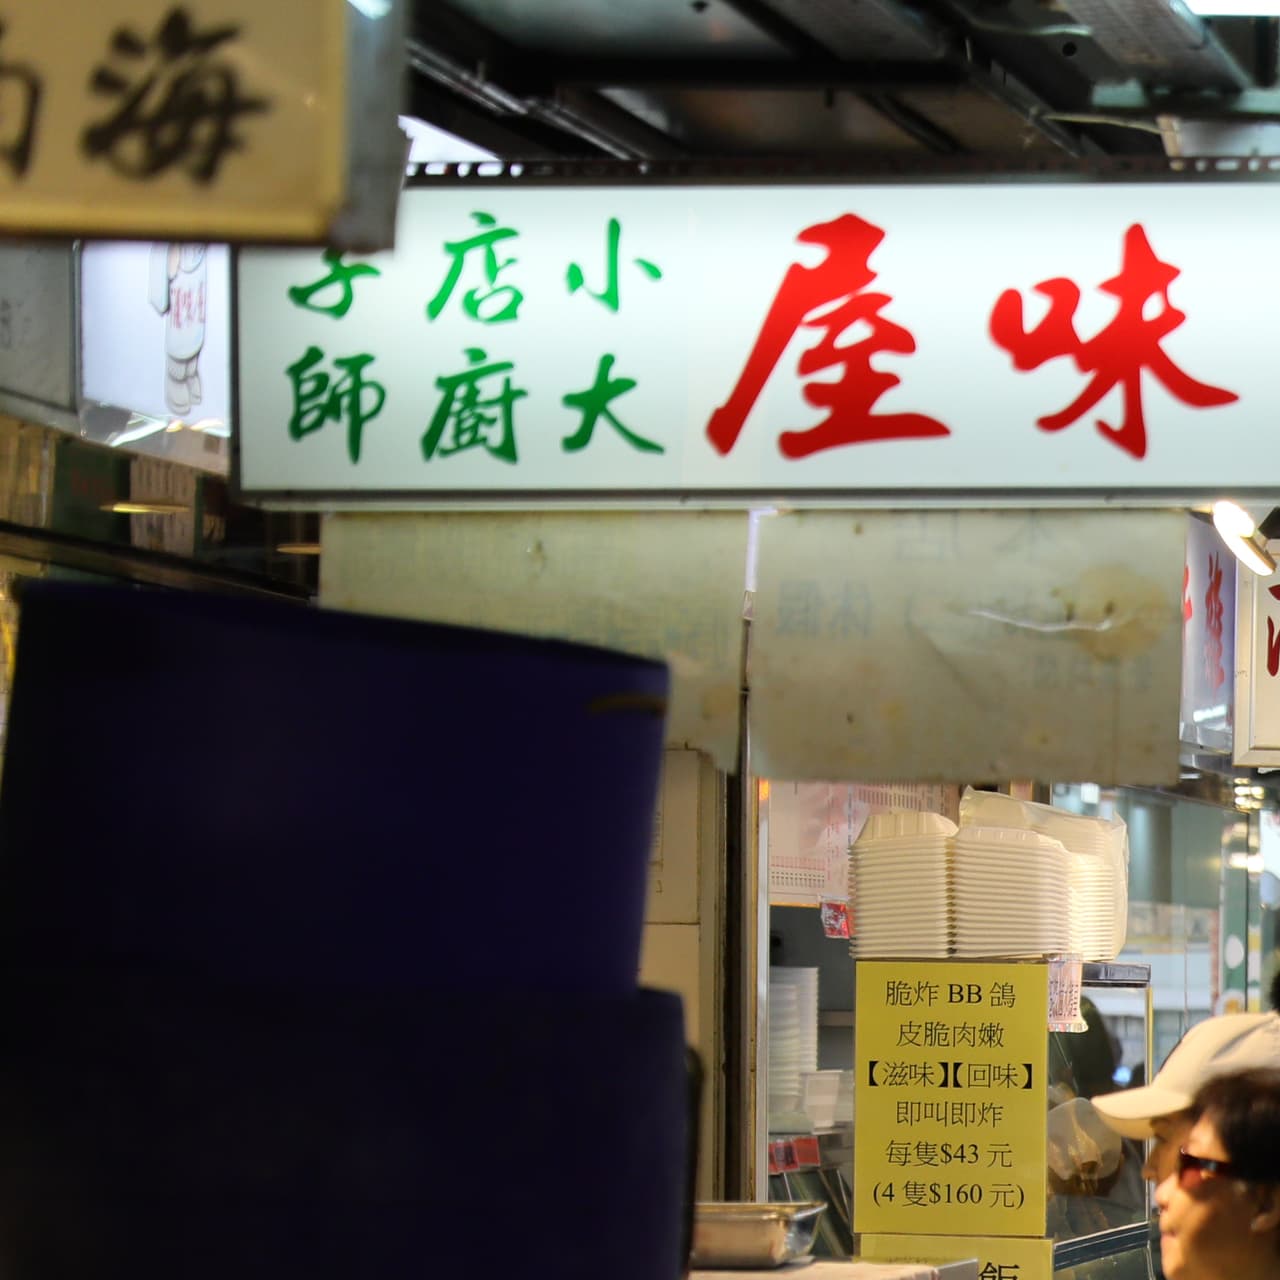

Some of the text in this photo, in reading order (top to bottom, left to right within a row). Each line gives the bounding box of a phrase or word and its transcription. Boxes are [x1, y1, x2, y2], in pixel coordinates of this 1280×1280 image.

[885, 980, 1016, 1008] 脆炸 BB 鴿
[896, 1021, 1005, 1048] 皮脆肉嫩
[896, 1101, 1004, 1129] 即叫即炸
[987, 1143, 1013, 1168] 元
